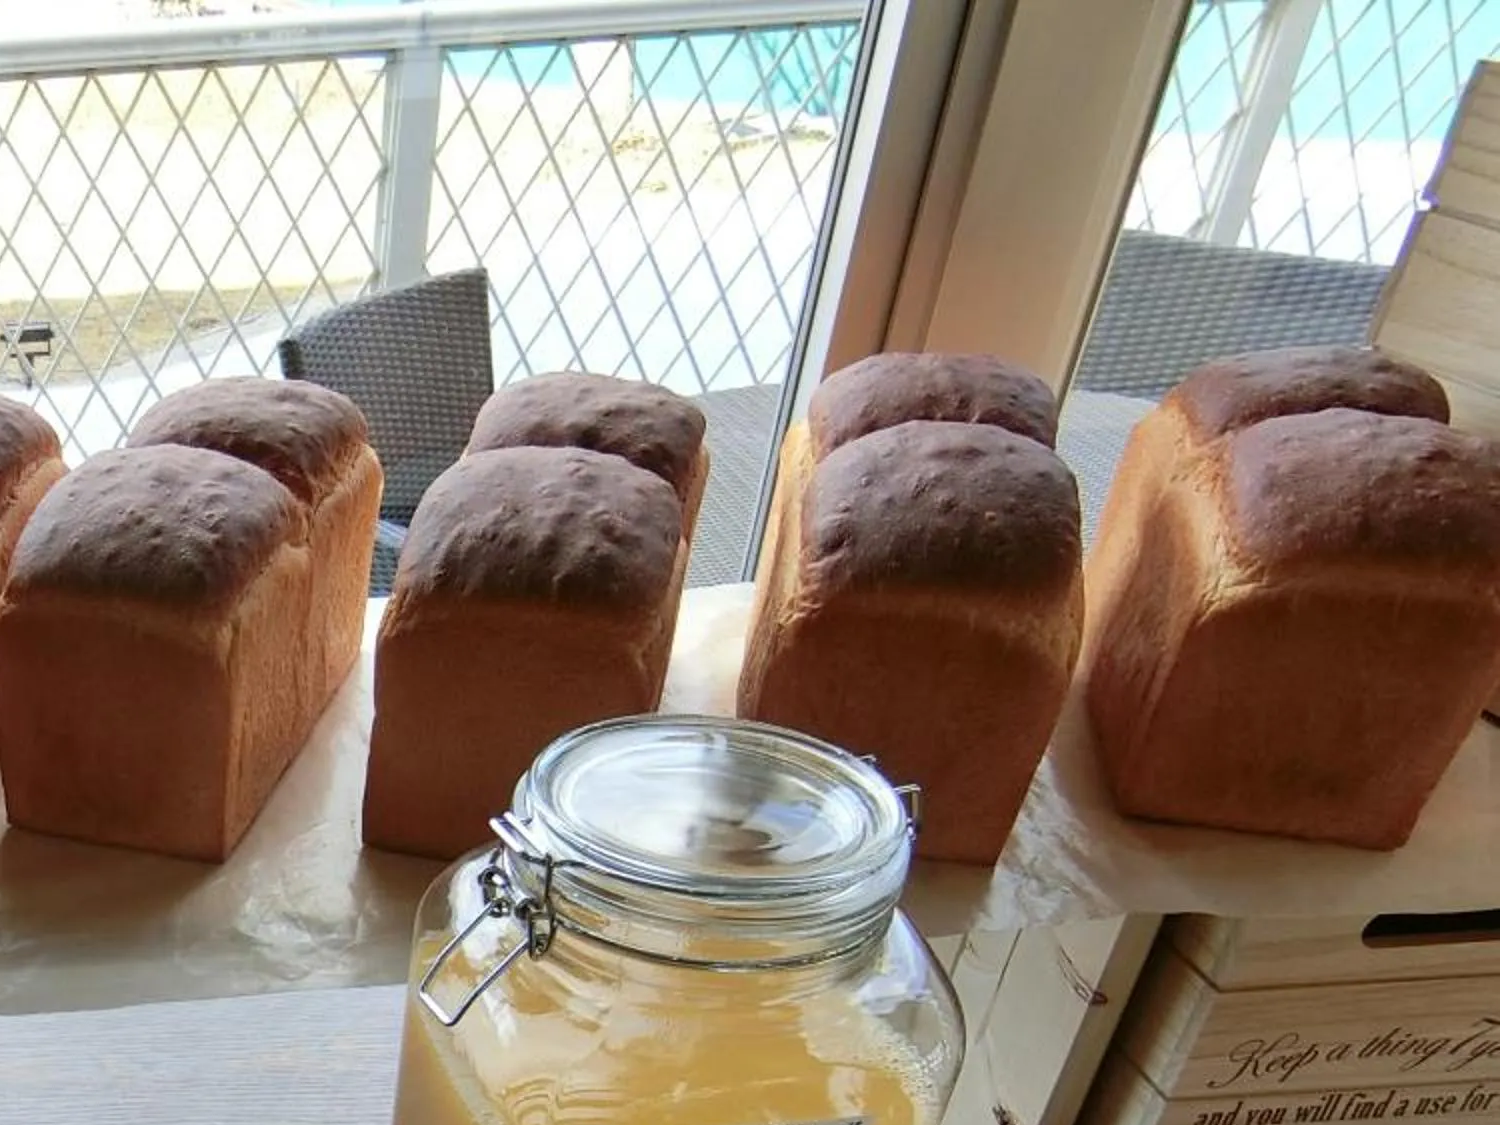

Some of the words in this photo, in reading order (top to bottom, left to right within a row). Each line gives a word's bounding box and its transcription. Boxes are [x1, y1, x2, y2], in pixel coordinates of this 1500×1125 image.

[1206, 1032, 1319, 1087] Keep
[1326, 1043, 1352, 1063] a
[1358, 1027, 1452, 1072] thing
[1295, 1093, 1343, 1122] will
[1339, 1089, 1397, 1120] find
[1392, 1099, 1410, 1117] a
[1414, 1096, 1458, 1116] use
[1459, 1083, 1500, 1112] for
